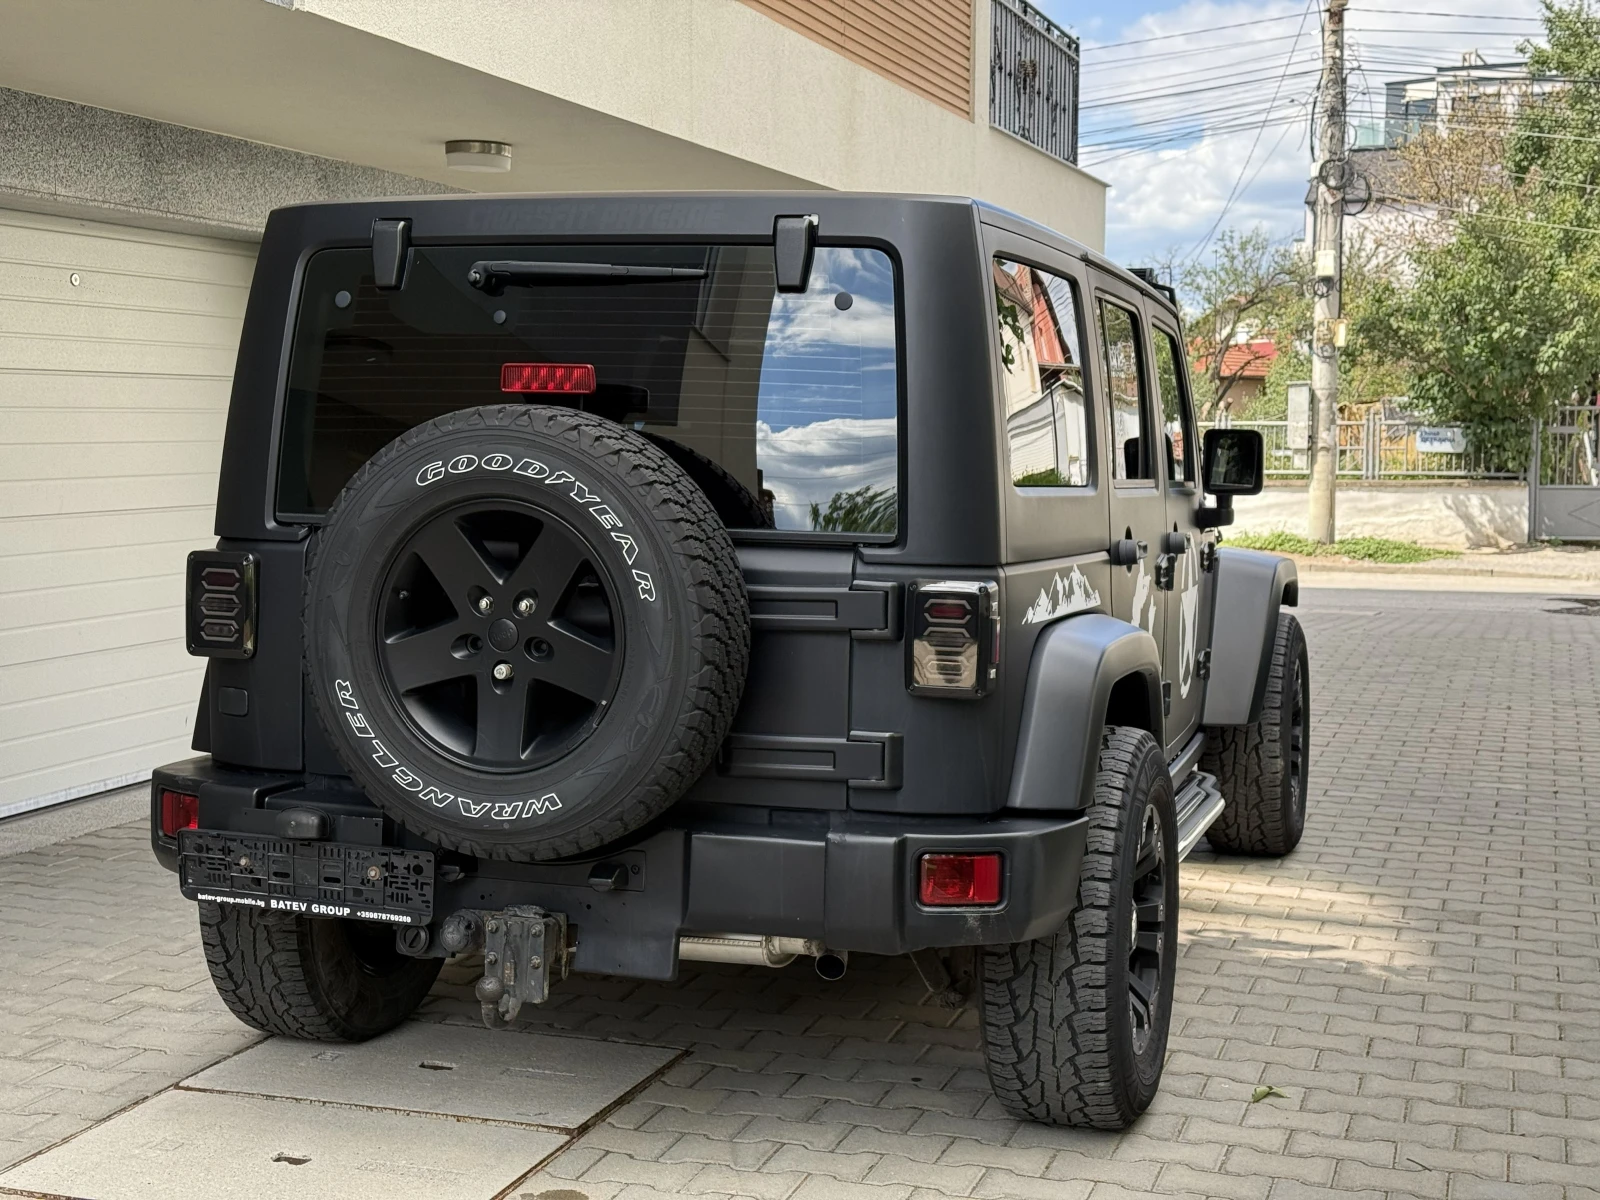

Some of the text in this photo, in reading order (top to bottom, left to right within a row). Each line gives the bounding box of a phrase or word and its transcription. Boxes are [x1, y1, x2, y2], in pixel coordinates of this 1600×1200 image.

[415, 453, 657, 602] GOODYEAR
[335, 679, 563, 820] WRANGLER
[197, 892, 265, 908] batev-group.mobile.bg
[270, 899, 308, 912] BATEV
[311, 903, 351, 917] GROUP
